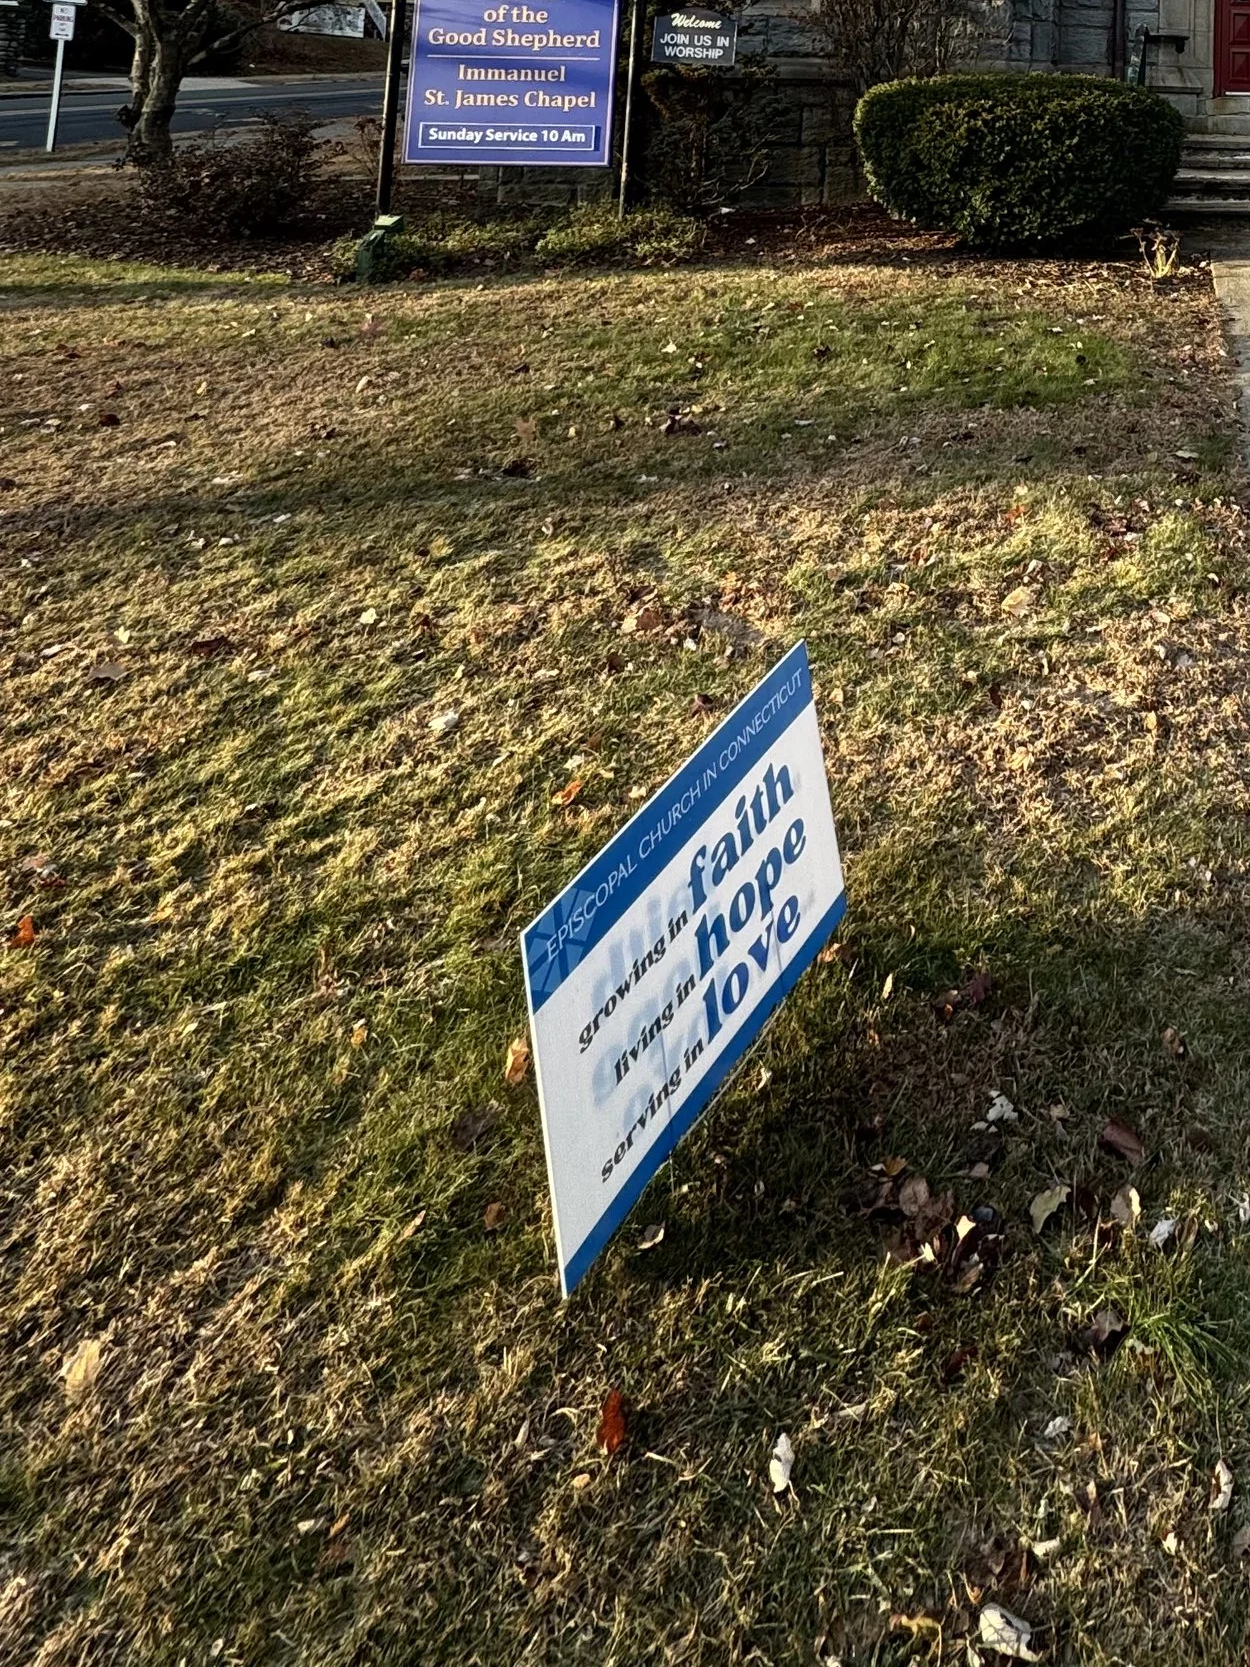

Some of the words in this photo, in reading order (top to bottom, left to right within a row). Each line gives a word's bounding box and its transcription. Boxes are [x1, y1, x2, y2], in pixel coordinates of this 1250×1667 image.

[483, 5, 510, 23] of
[511, 6, 549, 24] the
[670, 13, 723, 29] Welcome
[428, 28, 487, 46] Good
[492, 29, 601, 51] Shepherd
[660, 33, 689, 45] JOIN
[694, 35, 712, 46] US
[716, 36, 730, 47] IN
[664, 45, 724, 59] WORSHIP
[457, 64, 566, 82] Immanuel
[424, 89, 450, 106] St.
[454, 89, 519, 110] James
[524, 90, 596, 112] Chapel
[428, 127, 484, 144] Sunday
[485, 128, 538, 142] Service
[543, 129, 559, 142] 10
[561, 130, 586, 143] Am
[546, 854, 638, 961] EPISCOPAL
[639, 781, 700, 860] CHURCH
[702, 762, 717, 791] IN
[719, 667, 802, 771] CONNECTICUT
[578, 934, 667, 1054] growing
[668, 909, 689, 944] in
[688, 763, 795, 915] faith
[614, 1000, 674, 1086] living
[676, 974, 697, 1008] in
[694, 817, 807, 981] hope
[601, 1065, 682, 1184] serving
[684, 1037, 704, 1074] in
[703, 894, 801, 1045] love
